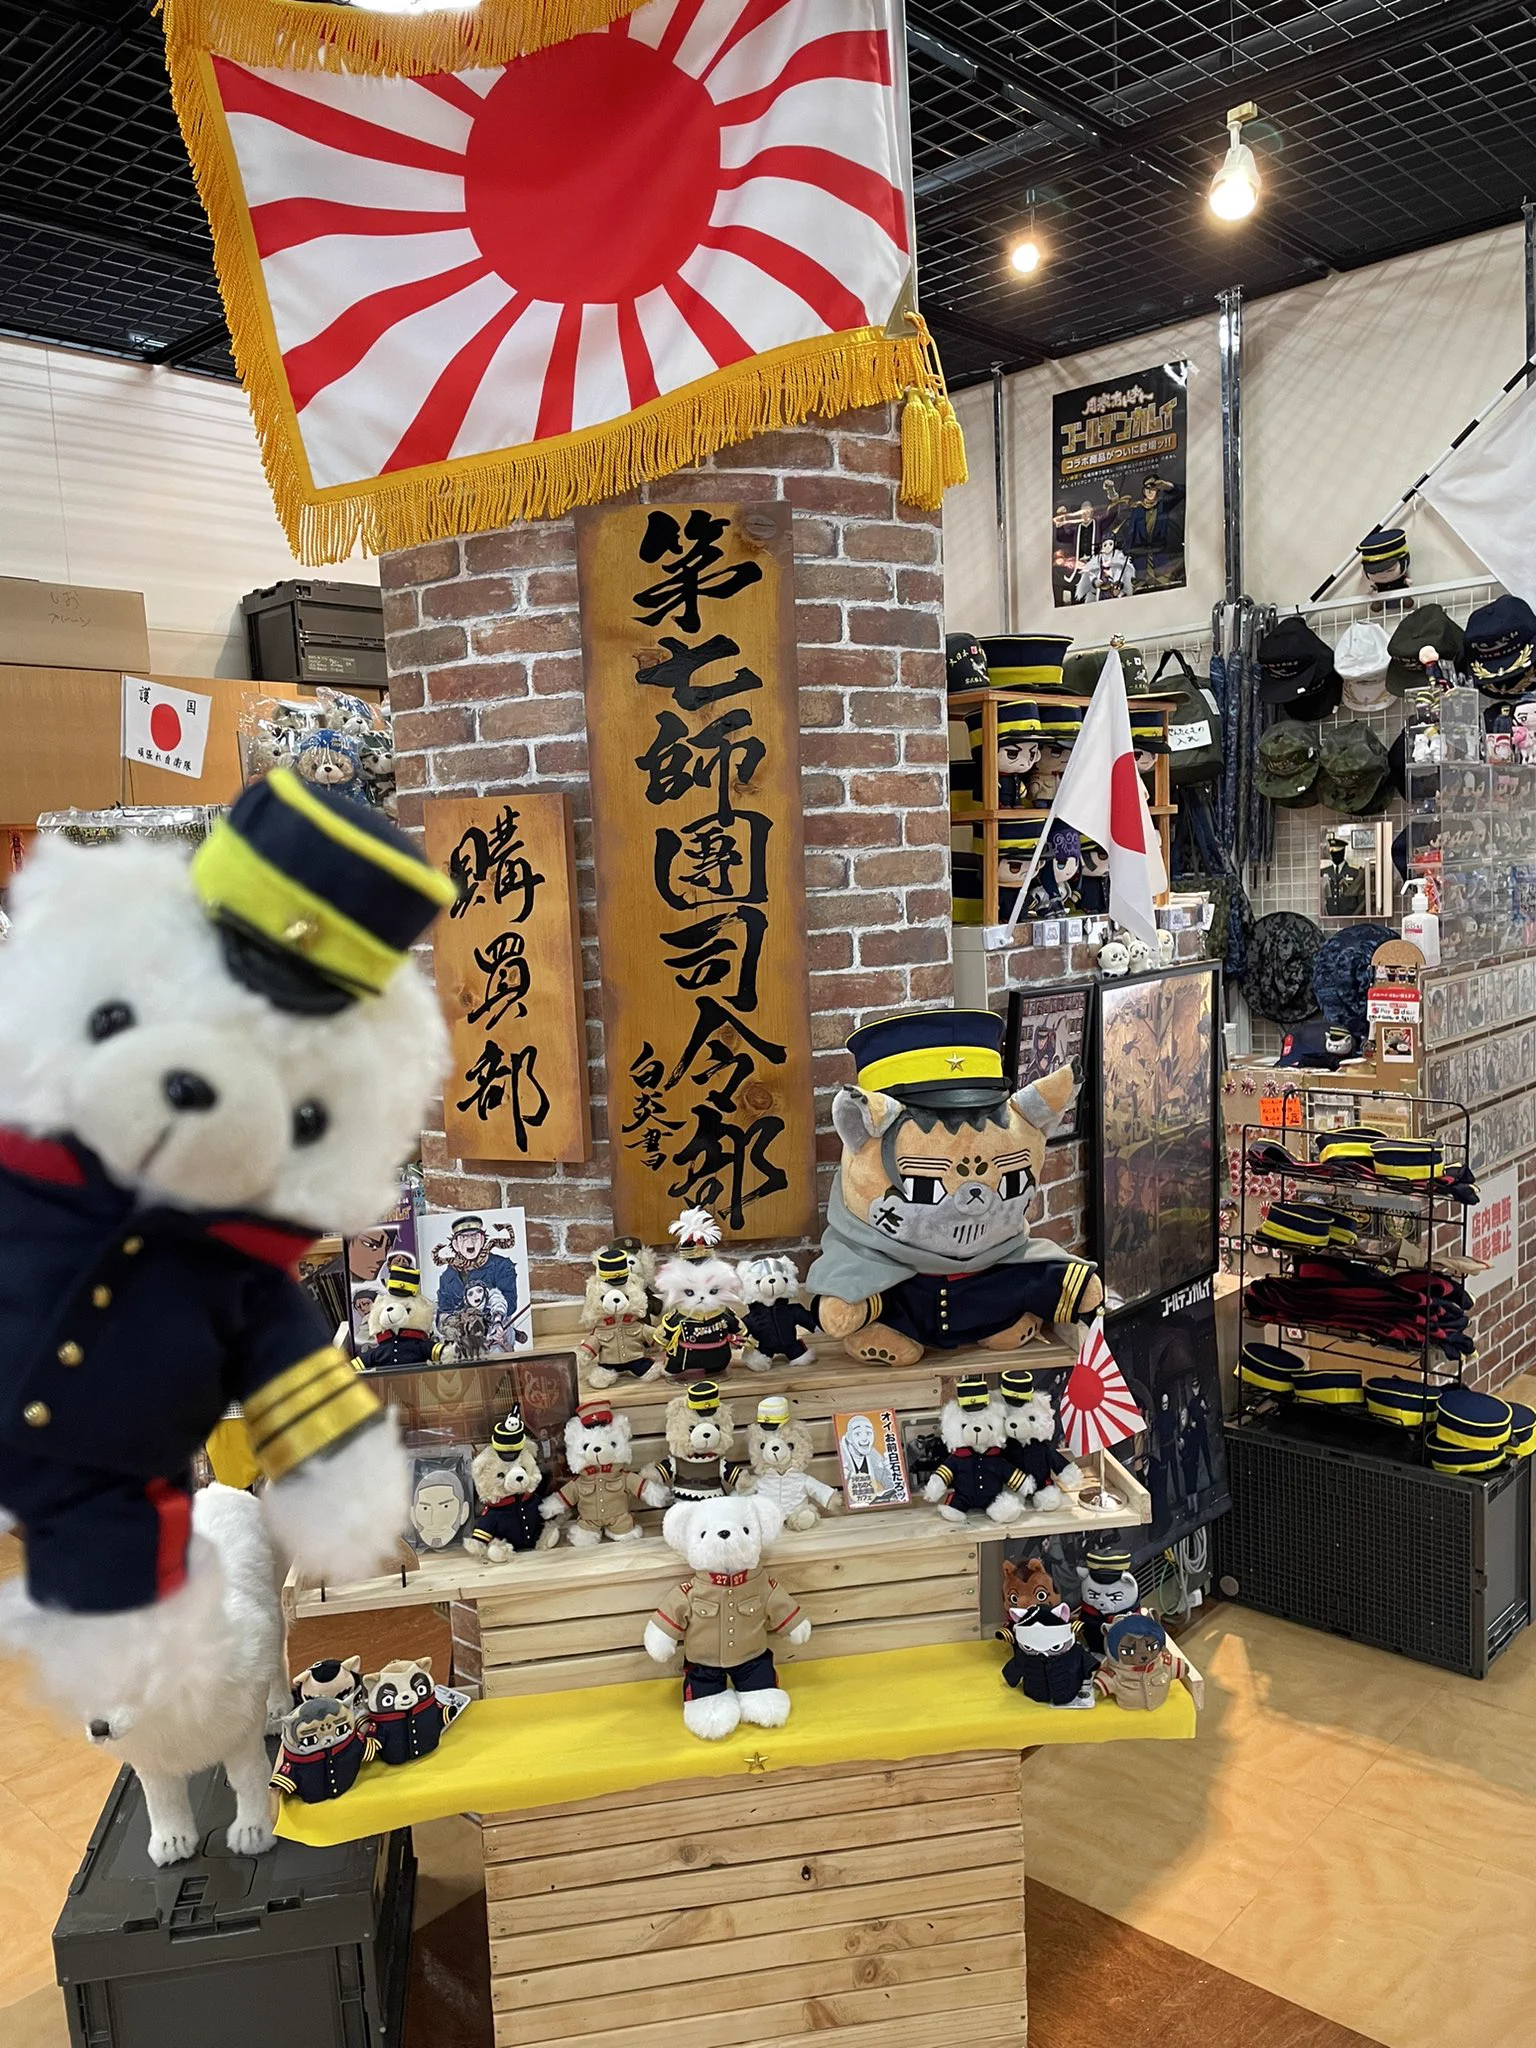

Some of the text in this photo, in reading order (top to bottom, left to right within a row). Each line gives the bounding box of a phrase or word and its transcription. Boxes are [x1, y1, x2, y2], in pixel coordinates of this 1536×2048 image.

[1060, 397, 1178, 455] ゴールデンカムイ
[632, 510, 788, 1230] 第七師團司令部
[450, 805, 551, 1153] 購買部
[1161, 1277, 1210, 1317] ゴールデンカムイ
[716, 1574, 744, 1584] 27 27
